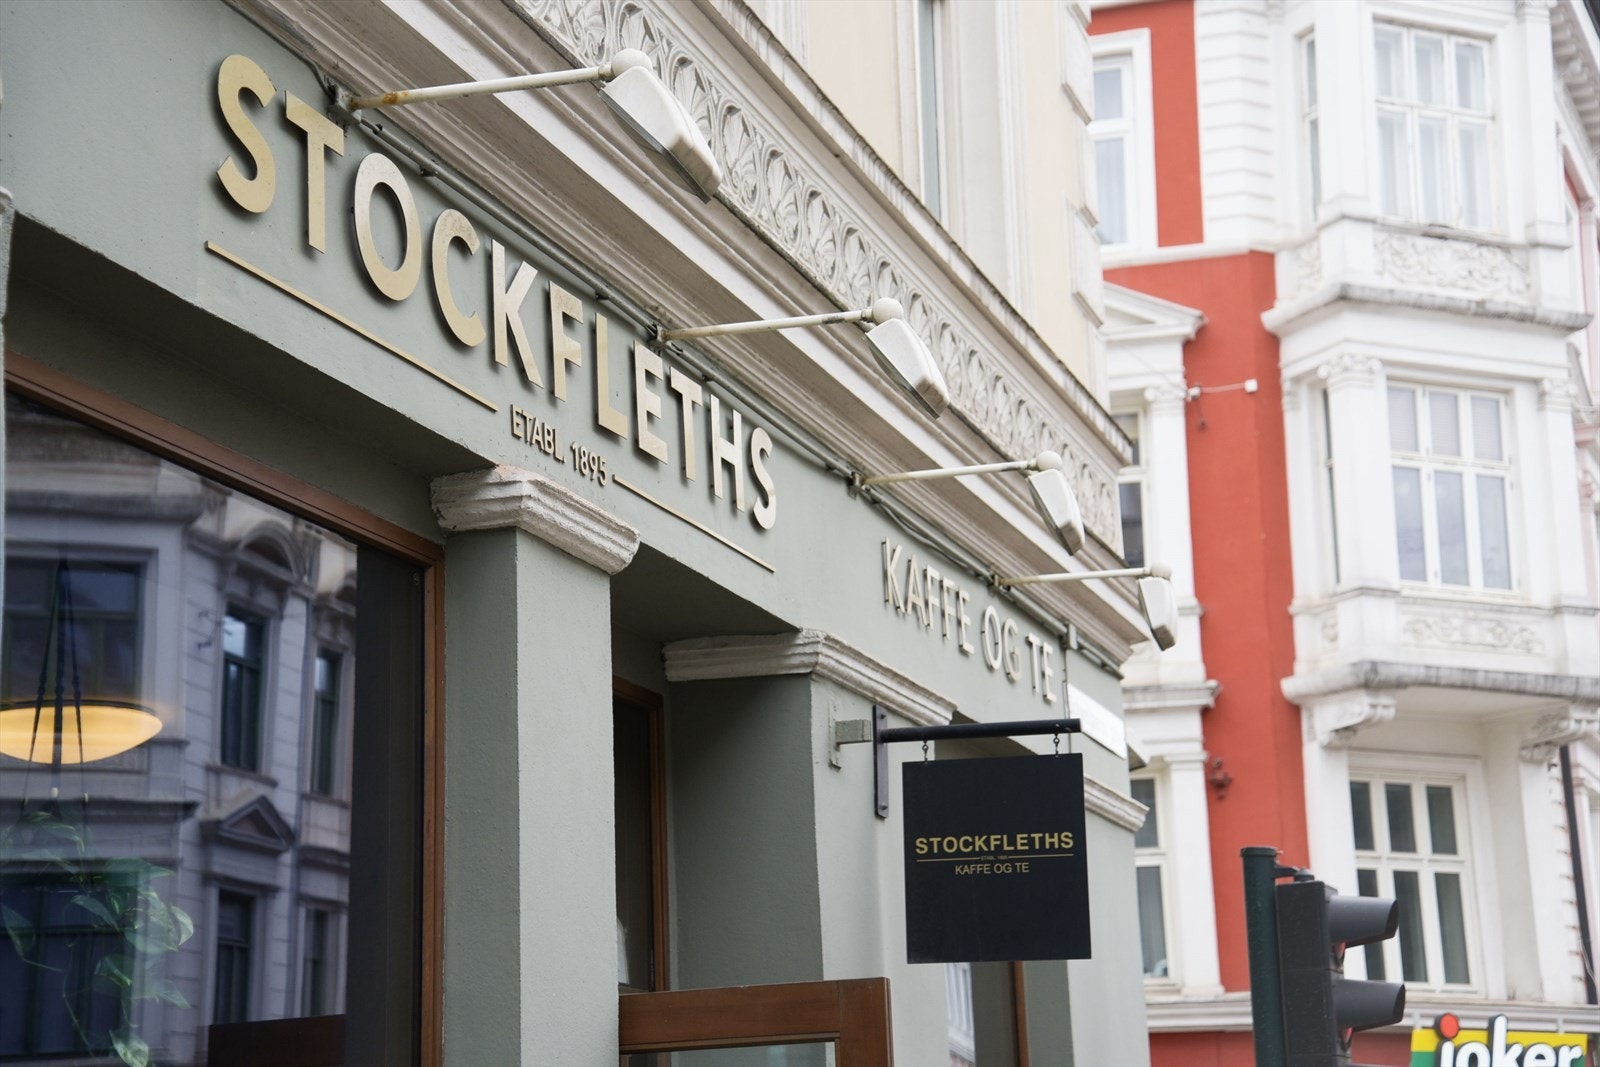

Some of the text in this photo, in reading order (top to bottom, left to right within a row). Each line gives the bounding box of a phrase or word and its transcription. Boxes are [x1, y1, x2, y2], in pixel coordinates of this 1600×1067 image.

[216, 54, 777, 530] STOCKFLETHS
[510, 403, 607, 486] ETABL. 1895
[881, 536, 1057, 703] KAFFE OG TE
[915, 831, 1074, 854] STOCKFLETHS
[955, 862, 1030, 875] KAFFE OG TE
